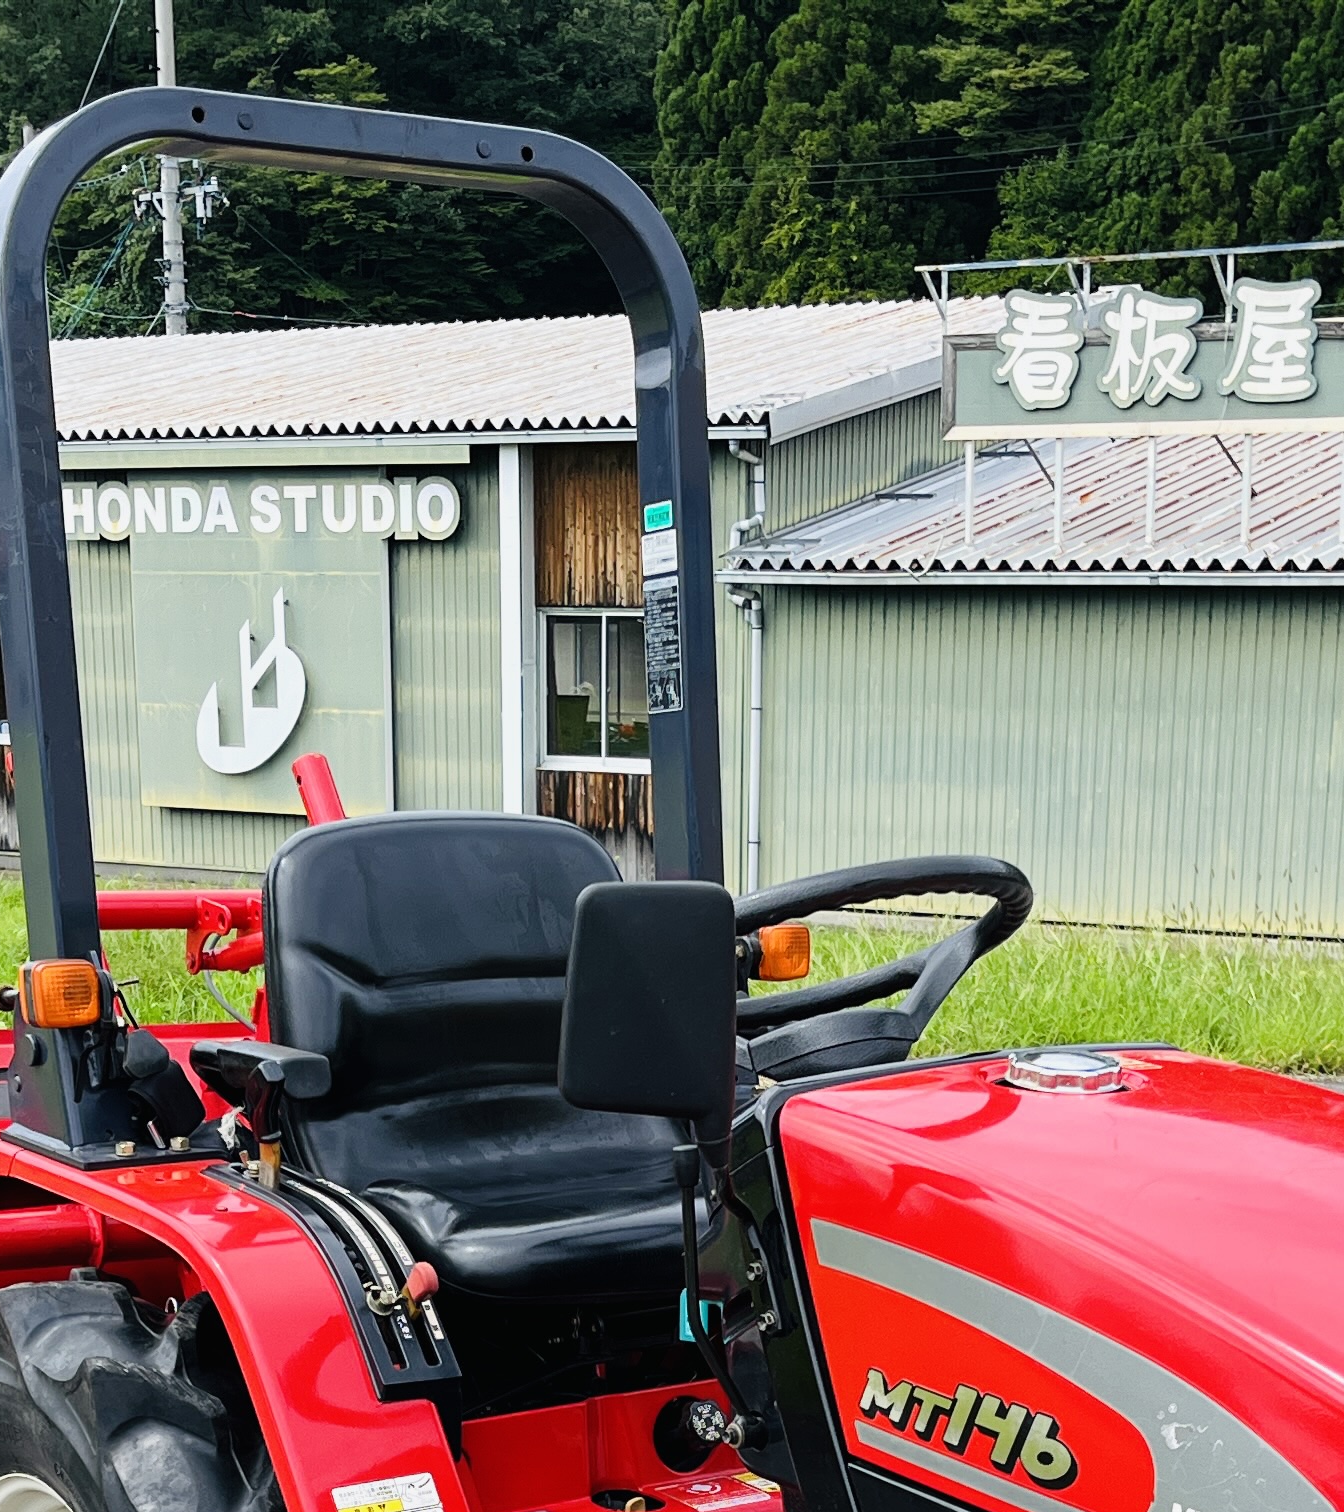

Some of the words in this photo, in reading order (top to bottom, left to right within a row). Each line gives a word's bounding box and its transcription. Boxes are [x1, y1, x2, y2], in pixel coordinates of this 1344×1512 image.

[995, 282, 1317, 404] 看板屋
[63, 485, 239, 534] HONDA
[249, 483, 457, 534] STUDIO
[858, 1368, 1077, 1487] MT146
